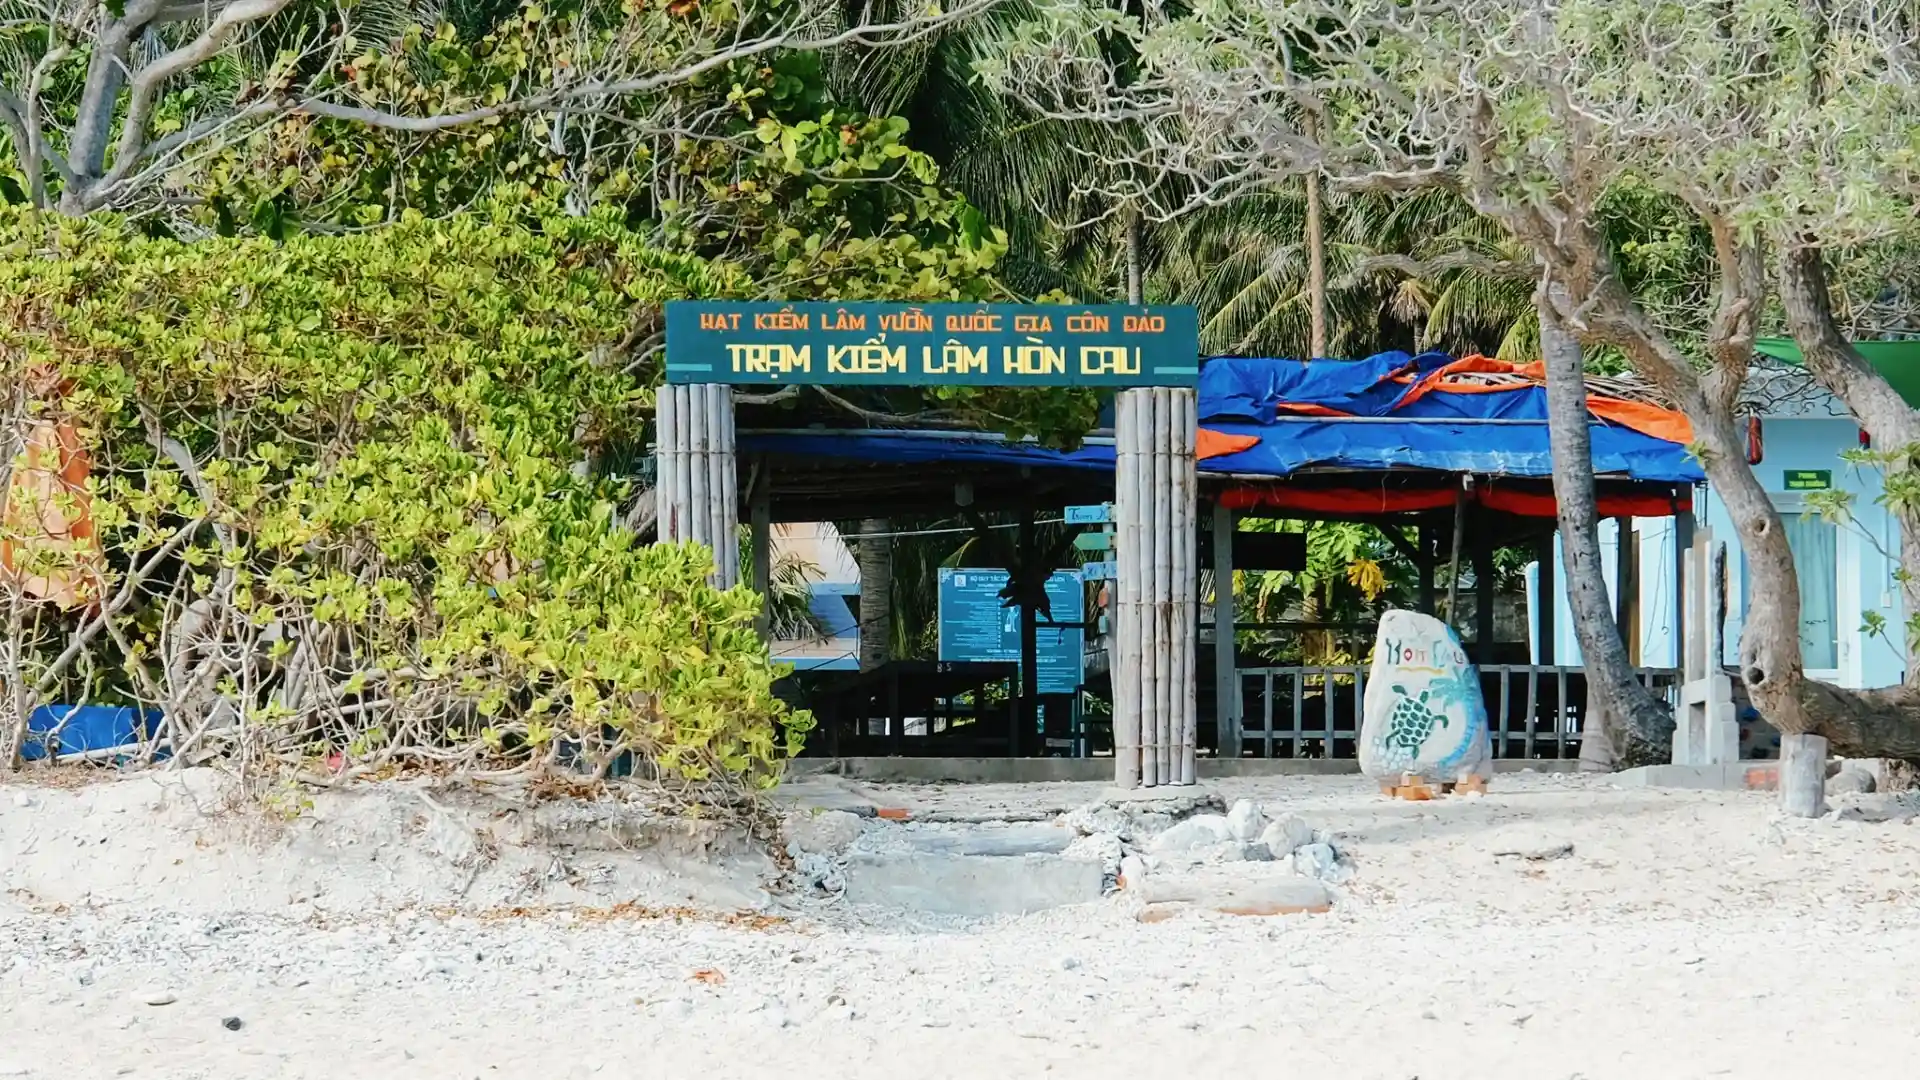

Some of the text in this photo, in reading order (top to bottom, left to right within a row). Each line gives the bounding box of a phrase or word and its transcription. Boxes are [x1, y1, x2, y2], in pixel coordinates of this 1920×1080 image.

[700, 313, 742, 334] HẠT
[754, 304, 809, 330] KIỂM
[821, 308, 866, 331] LÂM
[878, 307, 933, 332] VƯỜN
[945, 304, 1002, 332] QUỐC
[1014, 315, 1052, 332] GIA
[1066, 310, 1109, 332] CÔN
[725, 333, 1141, 379] TRẠM KIỂM LÂM HÒN CAU
